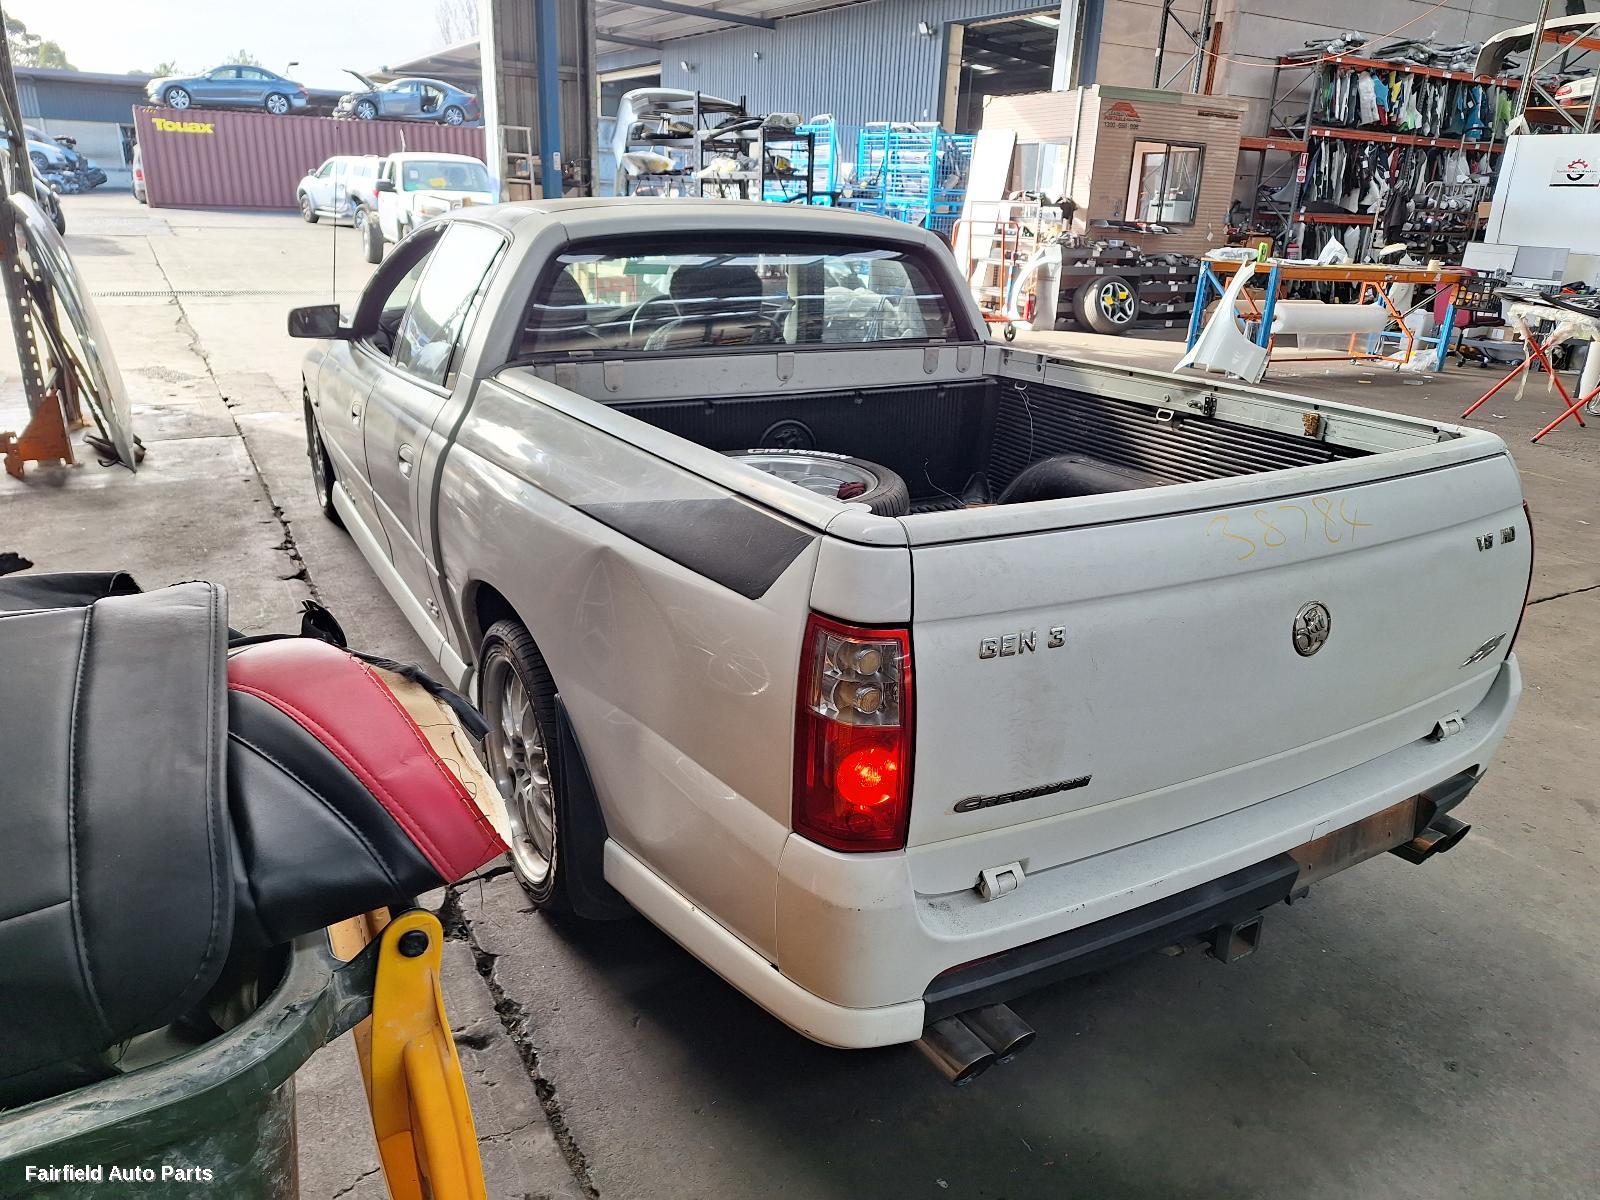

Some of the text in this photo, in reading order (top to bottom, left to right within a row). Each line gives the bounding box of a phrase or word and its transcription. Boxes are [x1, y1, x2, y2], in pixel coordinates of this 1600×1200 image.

[151, 117, 215, 134] Touax
[1206, 497, 1373, 561] 38784
[979, 626, 1066, 659] GEN 3
